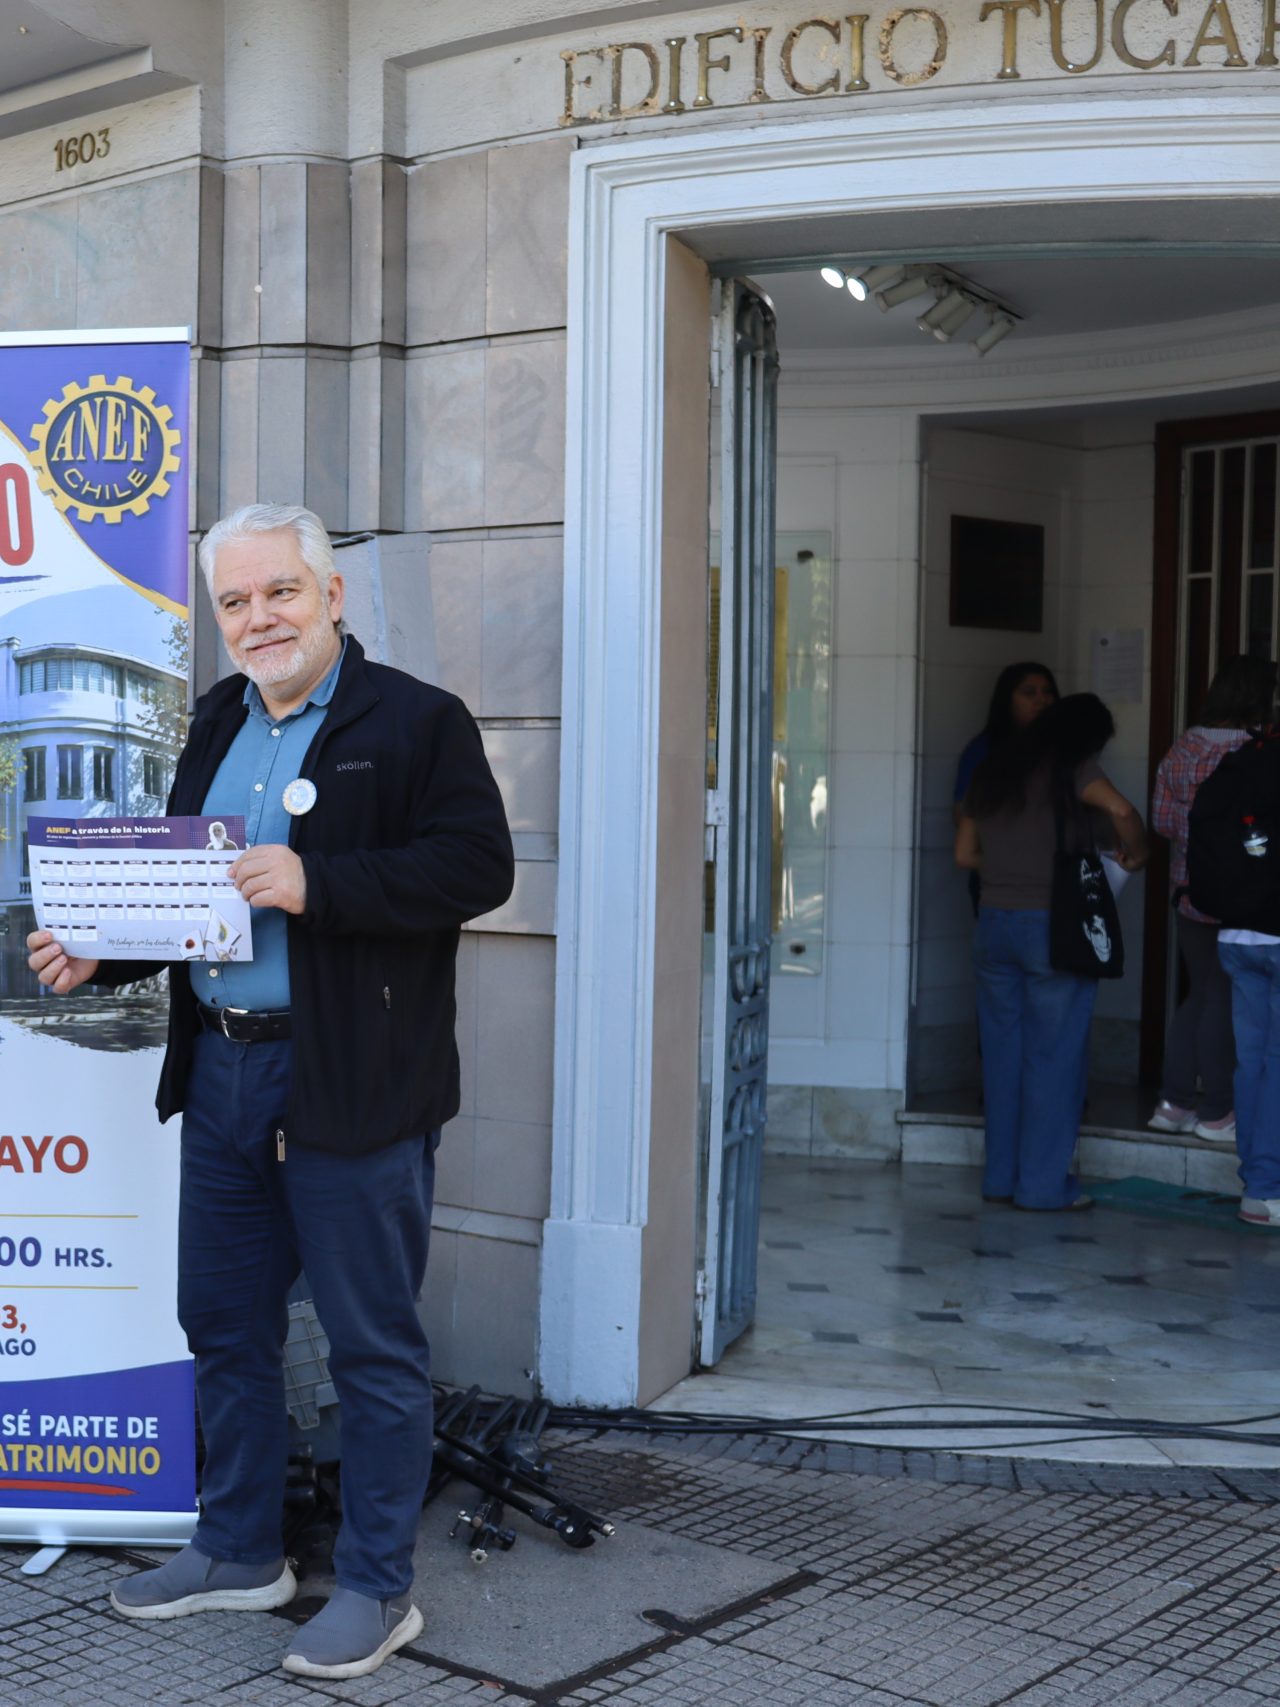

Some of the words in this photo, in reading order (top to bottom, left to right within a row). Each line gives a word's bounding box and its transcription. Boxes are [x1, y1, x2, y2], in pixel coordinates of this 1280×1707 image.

[560, 8, 948, 127] EDIFICIO
[54, 128, 111, 172] 1603
[51, 396, 151, 462] ANEF
[64, 468, 148, 500] CHILE
[123, 826, 132, 834] la
[134, 826, 171, 834] historia
[54, 1247, 113, 1268] HRS.
[1, 1408, 30, 1437] SÉ
[39, 1415, 118, 1439] PARTE
[126, 1416, 158, 1439] DE
